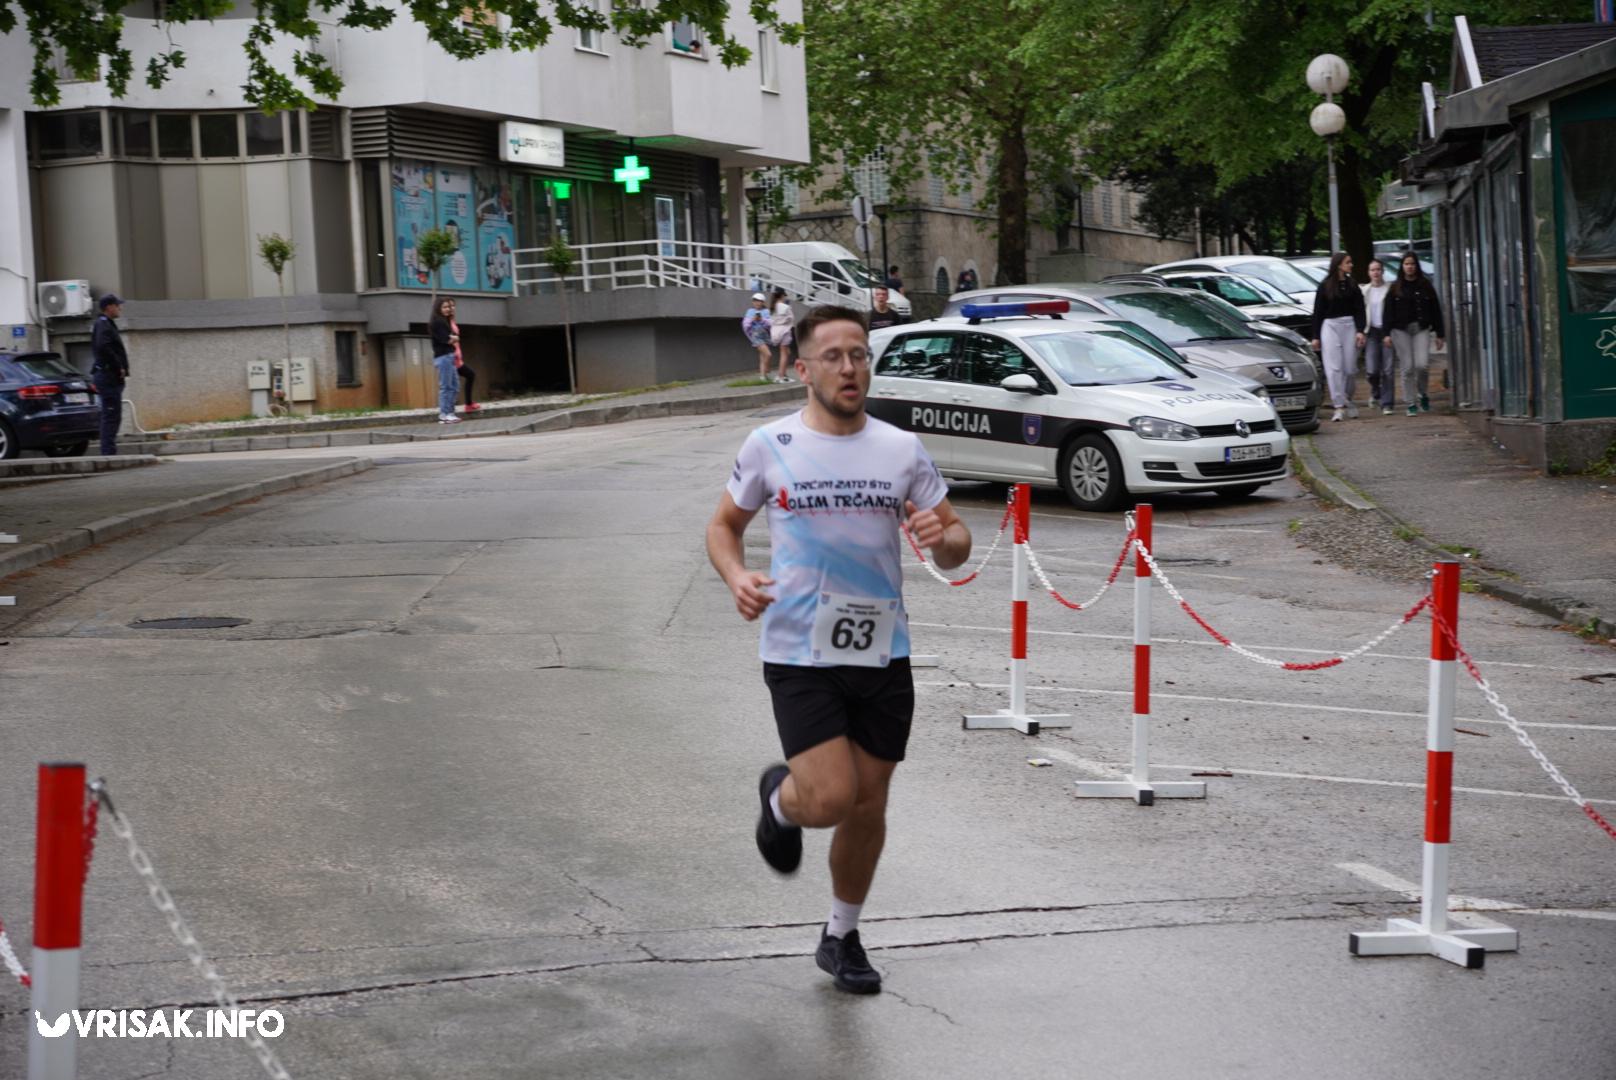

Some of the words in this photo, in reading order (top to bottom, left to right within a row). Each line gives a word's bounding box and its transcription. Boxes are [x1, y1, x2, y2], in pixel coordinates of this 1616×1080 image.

[911, 406, 992, 434] POLICIJA
[834, 479, 867, 489] ZATO
[831, 617, 876, 652] 63
